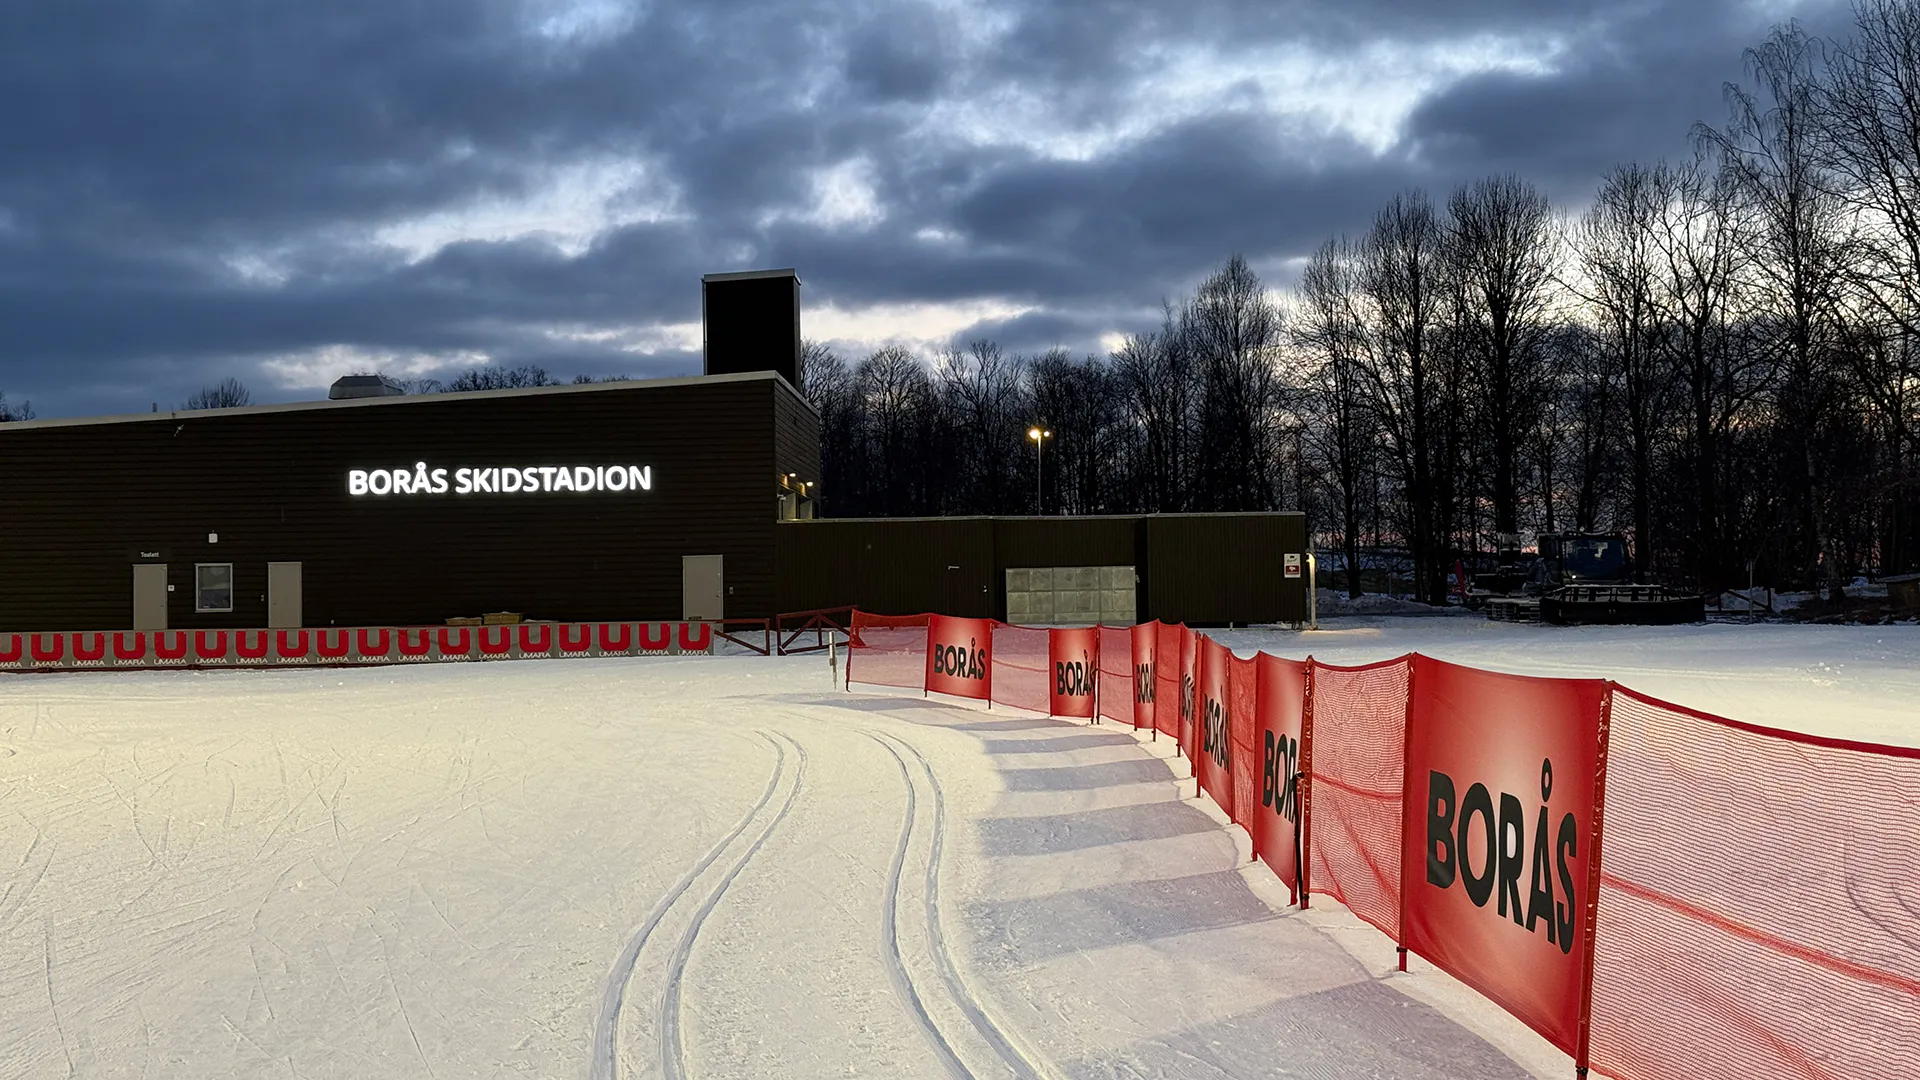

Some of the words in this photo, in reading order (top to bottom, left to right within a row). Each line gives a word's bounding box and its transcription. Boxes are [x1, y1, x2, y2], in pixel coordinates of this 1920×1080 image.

[349, 461, 448, 495] BORÅS
[455, 465, 651, 493] SKIDSTADION
[934, 637, 985, 680] BORÅS
[1056, 649, 1094, 696] BORÅS
[1262, 729, 1297, 824] BOR
[1427, 758, 1577, 954] BORÅS
